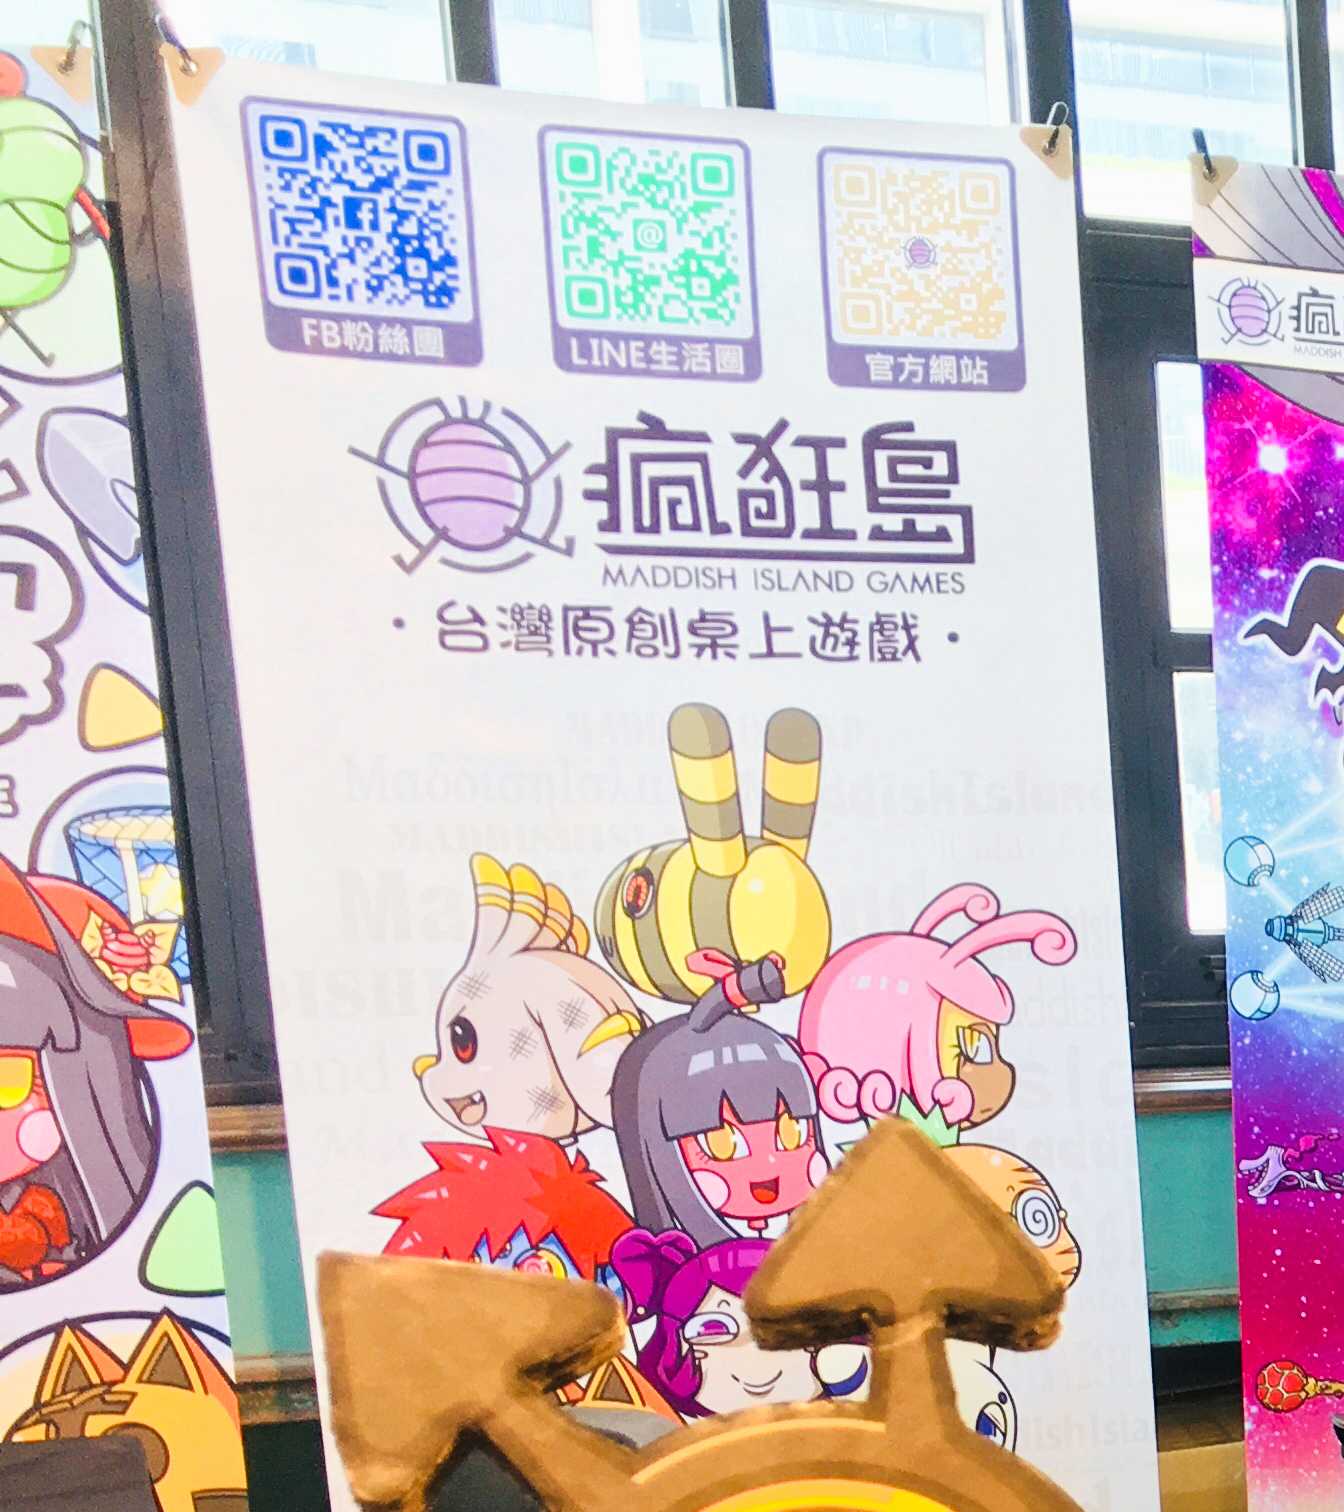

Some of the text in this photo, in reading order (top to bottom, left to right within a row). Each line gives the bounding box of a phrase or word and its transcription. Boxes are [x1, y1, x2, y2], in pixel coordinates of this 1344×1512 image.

[302, 316, 447, 360] FB粉絲團
[1293, 344, 1342, 359] MADDISH
[570, 337, 746, 376] LINE生活圈
[864, 352, 990, 386] 官方網站
[583, 411, 975, 563] 瘋狂島
[602, 563, 967, 596] MADDISH ISLAND GAMES
